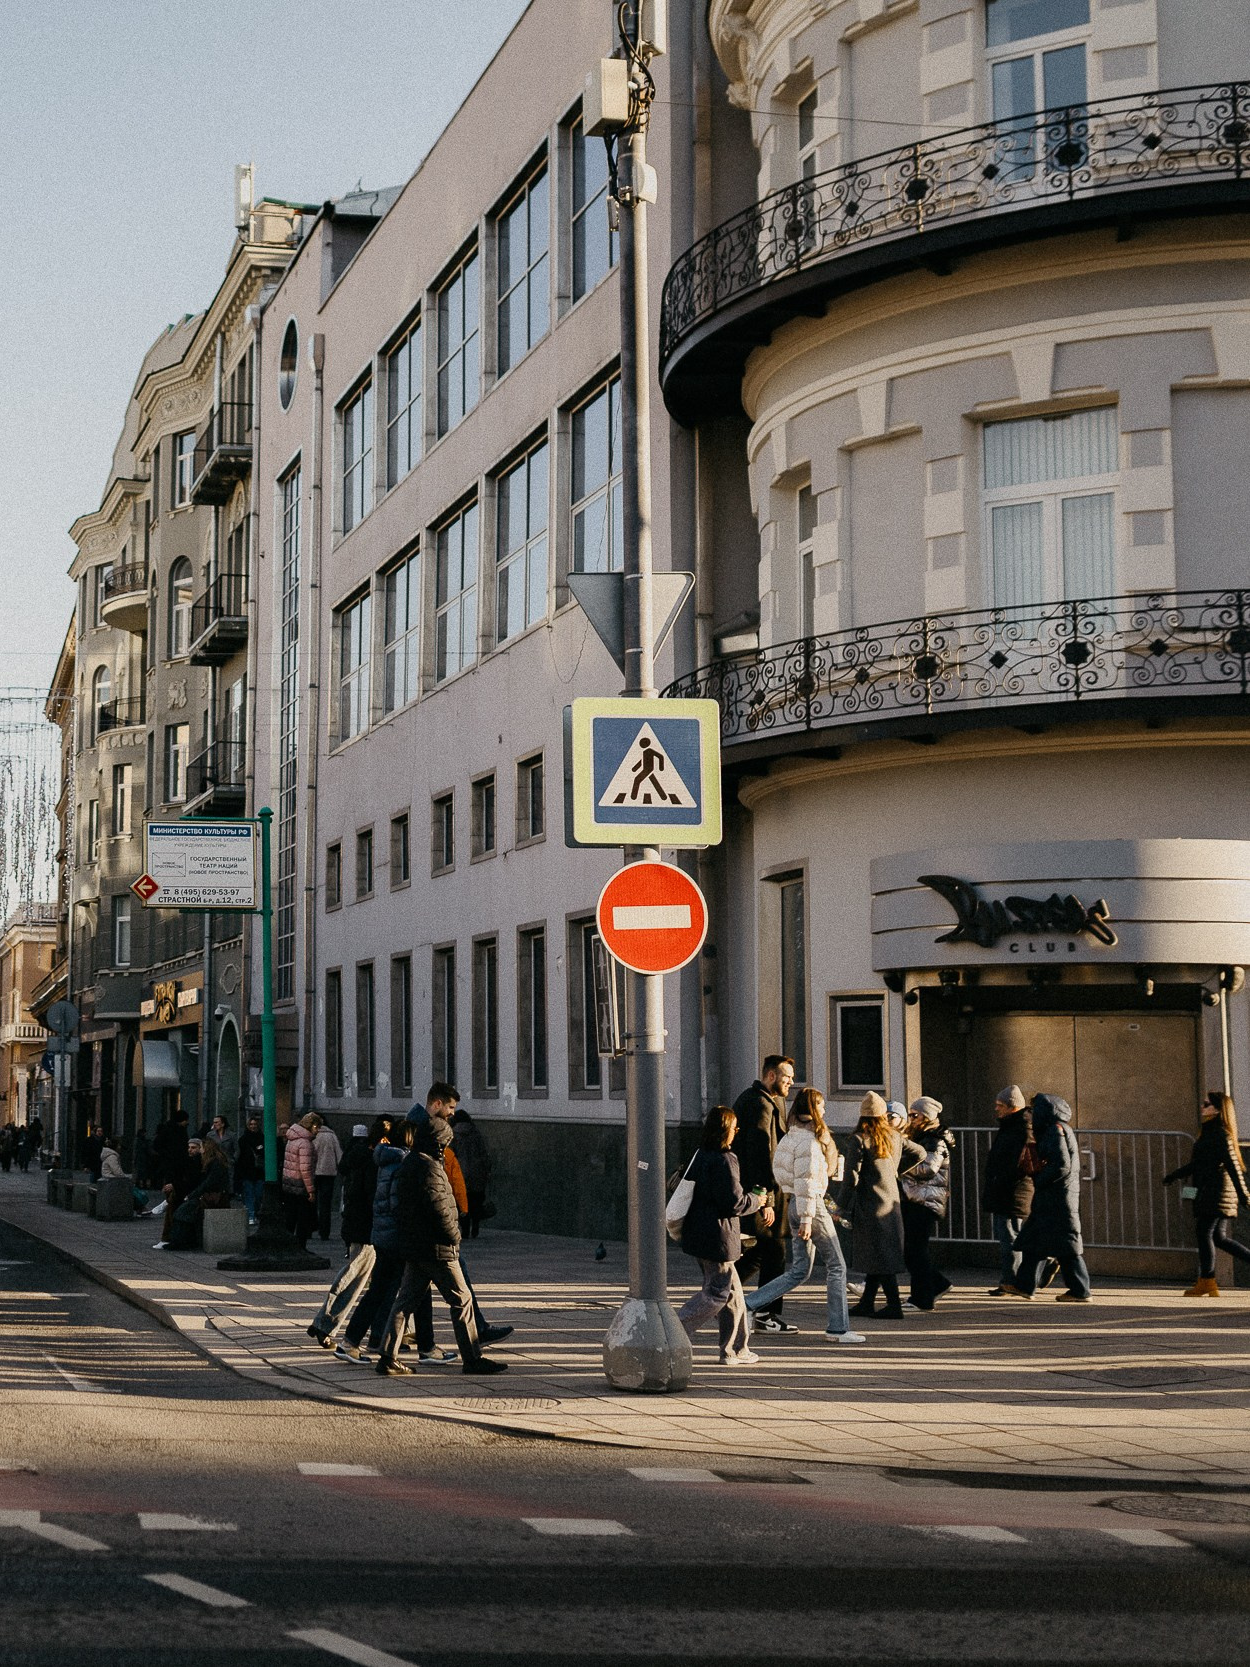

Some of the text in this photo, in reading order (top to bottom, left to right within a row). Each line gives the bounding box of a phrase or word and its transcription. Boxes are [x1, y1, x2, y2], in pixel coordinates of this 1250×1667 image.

[153, 827, 203, 835] МИНИСТЕРСТВО
[181, 888, 200, 896] (495)
[1009, 942, 1076, 953] CLUB
